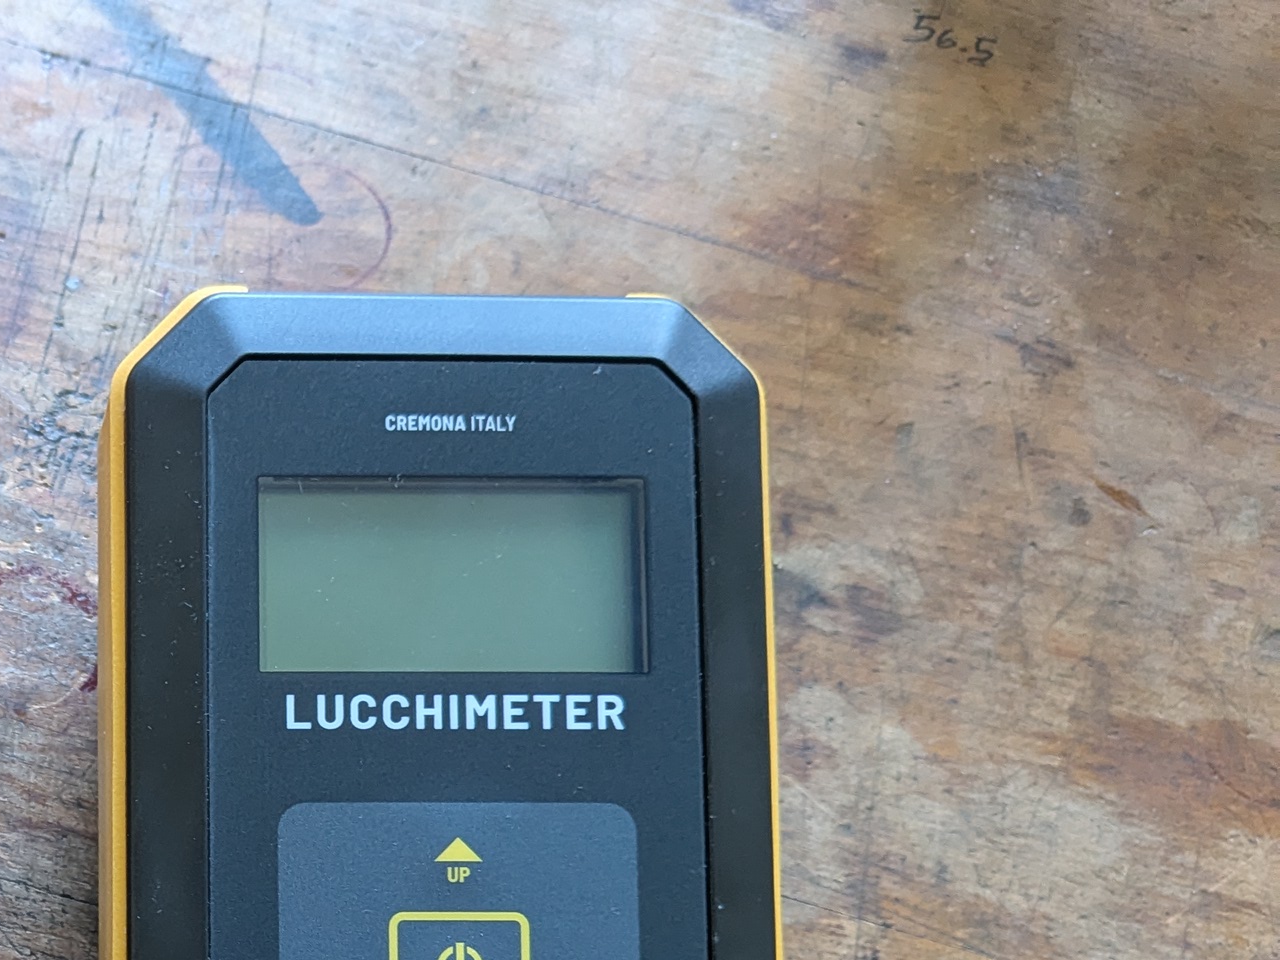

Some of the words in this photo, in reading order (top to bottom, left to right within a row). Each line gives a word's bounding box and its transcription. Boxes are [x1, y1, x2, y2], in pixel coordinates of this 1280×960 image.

[903, 13, 998, 67] 56.5
[384, 414, 467, 432] CREMONA
[470, 414, 517, 432] ITALY
[285, 693, 626, 731] LUCCHIMETER
[447, 866, 471, 883] UP
